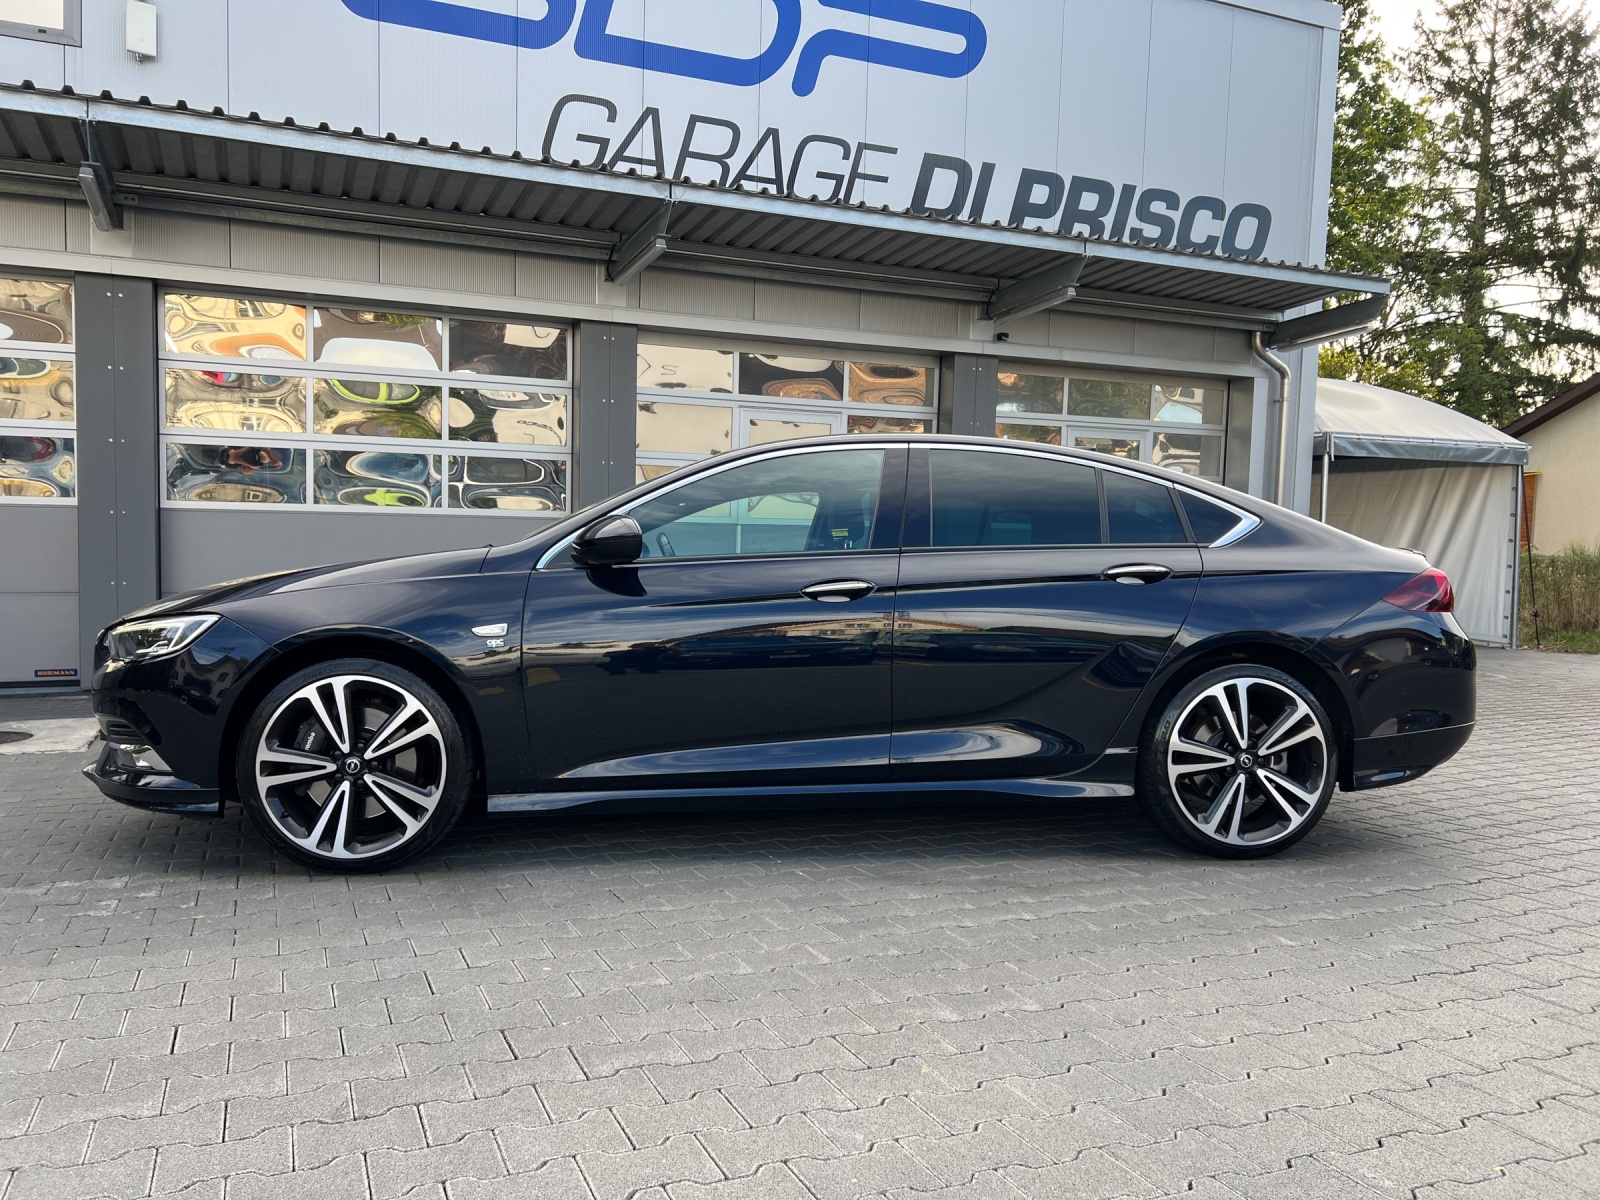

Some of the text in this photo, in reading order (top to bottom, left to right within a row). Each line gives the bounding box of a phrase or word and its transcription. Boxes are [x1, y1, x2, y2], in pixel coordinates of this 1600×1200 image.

[541, 93, 1272, 261] GARAGE DI PRISCO
[304, 731, 316, 751] rembo
